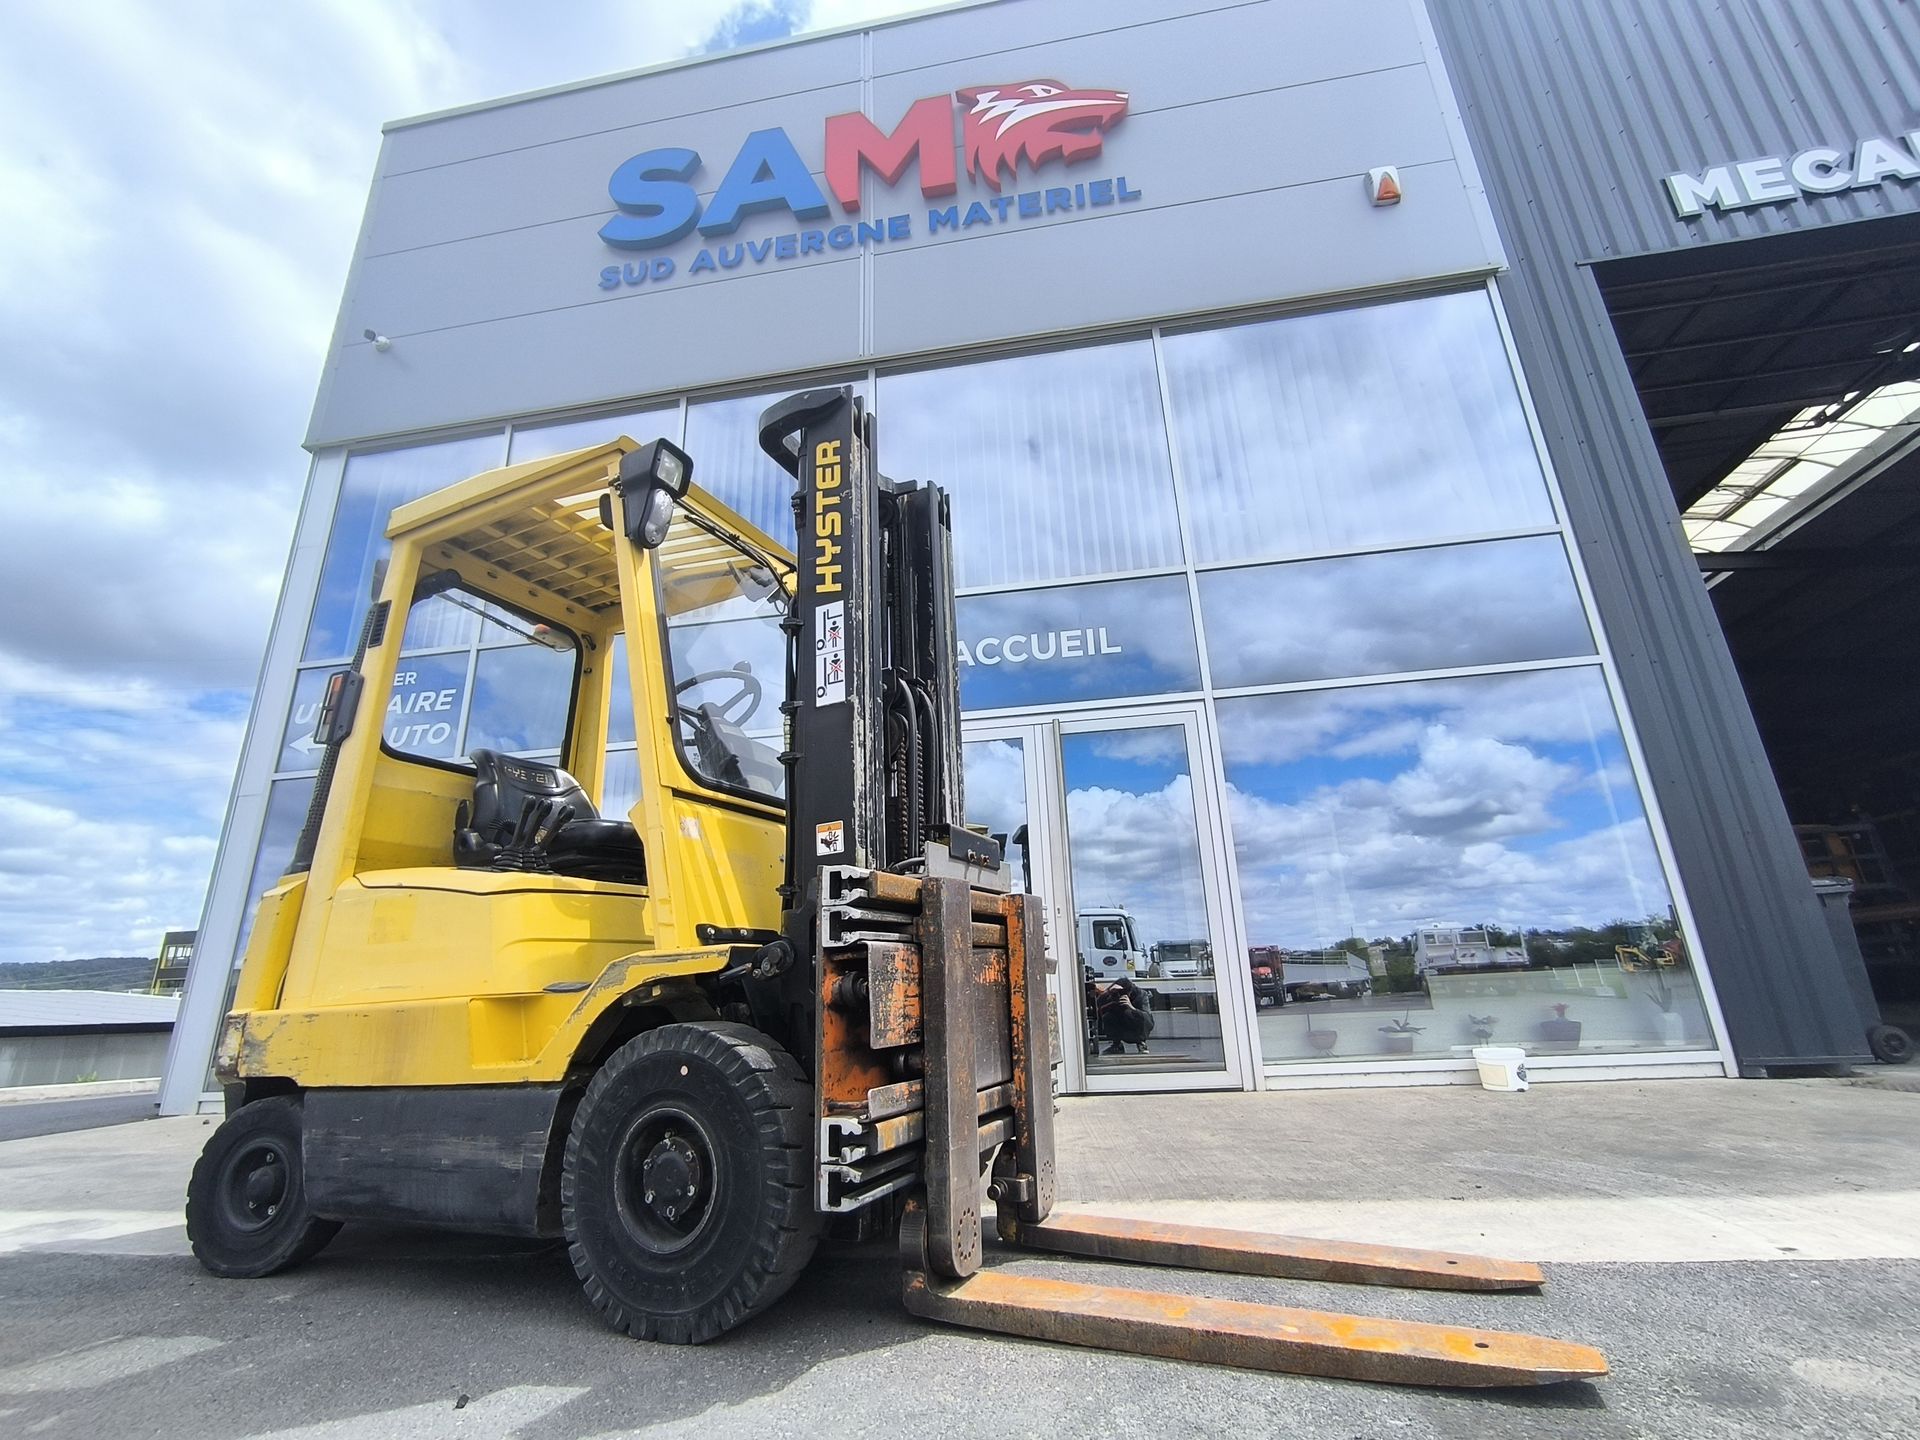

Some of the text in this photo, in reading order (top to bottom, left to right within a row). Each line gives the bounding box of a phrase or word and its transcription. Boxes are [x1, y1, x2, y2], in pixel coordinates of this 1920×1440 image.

[597, 93, 957, 250] SAM
[598, 176, 1142, 289] SUD AUVERGNE MATERIEL
[816, 440, 842, 593] HYSTER
[957, 627, 1122, 667] ACCUEIL
[388, 722, 451, 748] UTO
